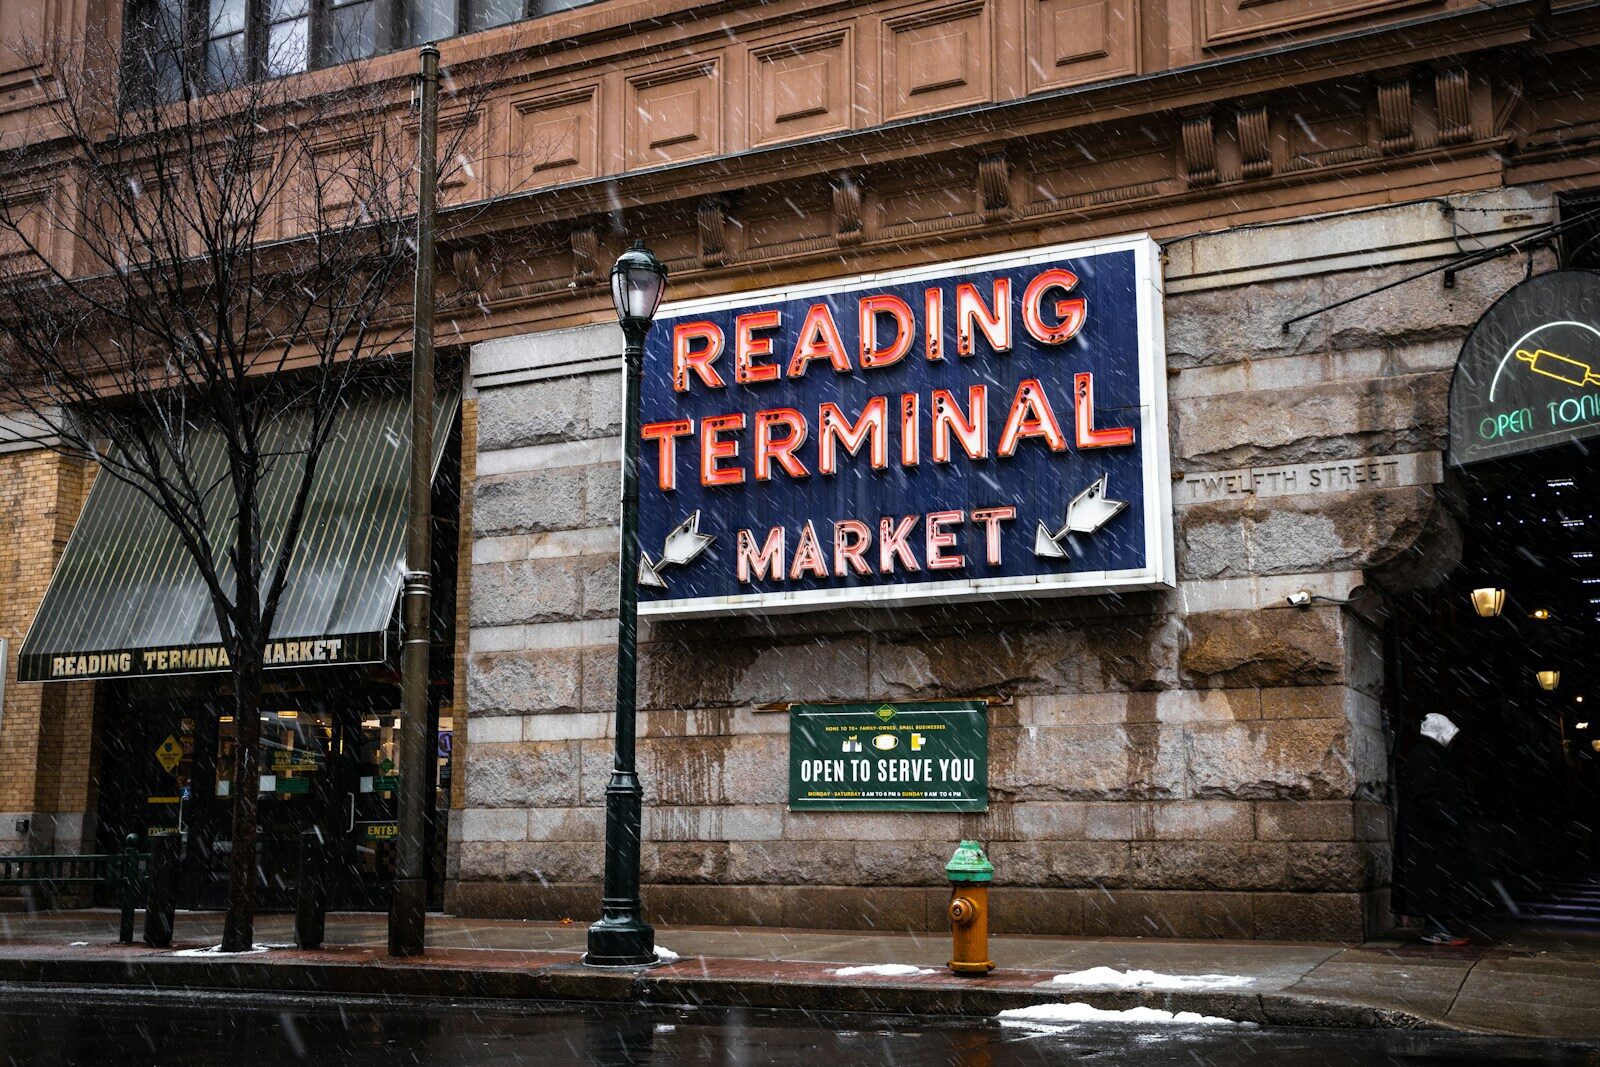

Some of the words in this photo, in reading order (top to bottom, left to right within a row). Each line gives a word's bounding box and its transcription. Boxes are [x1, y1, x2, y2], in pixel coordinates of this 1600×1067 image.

[673, 268, 1088, 392] READING
[641, 372, 1136, 491] TERMINAL
[1479, 408, 1533, 440] OPEN
[1546, 392, 1600, 426] TONI
[1186, 469, 1297, 499] TWELFTH
[1308, 462, 1399, 488] STREET
[736, 506, 1017, 584] MARKET
[52, 652, 131, 677] READING
[143, 646, 231, 671] TERMINA
[800, 759, 844, 782] OPEN
[850, 759, 871, 782] TO
[877, 758, 933, 782] SERVE
[939, 758, 975, 782] YOU
